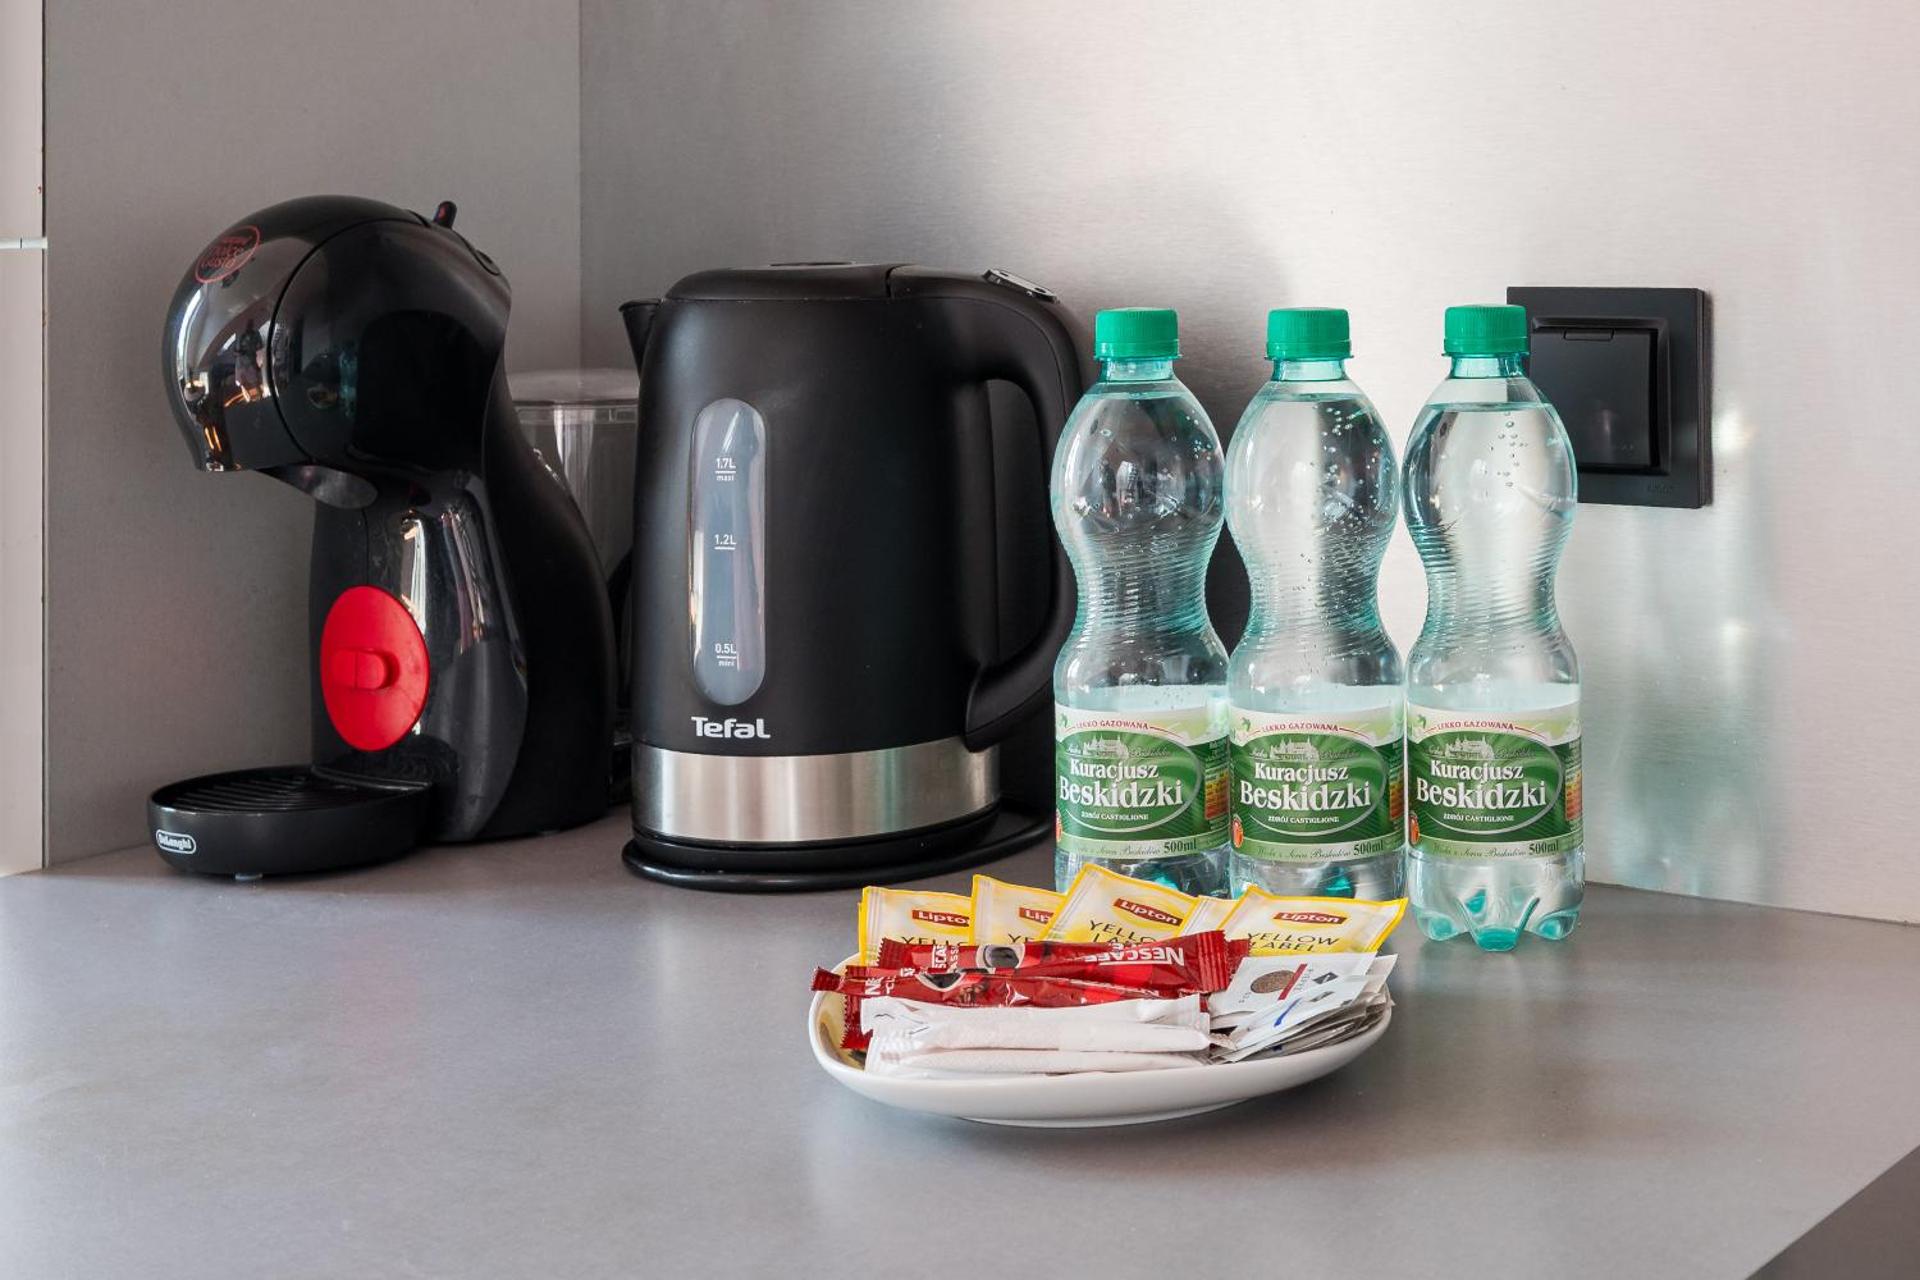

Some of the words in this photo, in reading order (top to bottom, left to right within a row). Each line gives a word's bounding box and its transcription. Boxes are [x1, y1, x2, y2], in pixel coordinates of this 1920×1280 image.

[715, 457, 737, 470] 1.7L
[714, 533, 737, 545] 1.2L
[714, 643, 737, 655] 0.5L
[690, 715, 771, 739] Tefal
[1100, 720, 1149, 730] GAZOWANA
[1288, 722, 1339, 732] GAZOWANA
[1463, 721, 1514, 731] GAZOWANA
[1070, 758, 1159, 785] Kuracjusz
[1254, 762, 1349, 785] Kuracjusz
[1430, 759, 1524, 783] Kuracjusz
[1059, 776, 1183, 808] Beskidzki
[1240, 780, 1372, 811] Beskidzki
[1416, 777, 1547, 810] Beskidzki
[1163, 838, 1197, 854] 500ml
[1353, 841, 1384, 856] 500ml
[1528, 840, 1559, 856] 500ml
[918, 910, 969, 925] Lipto
[1121, 901, 1179, 926] Lipton
[1281, 912, 1340, 924] Lipton
[1247, 932, 1340, 946] YELLOW
